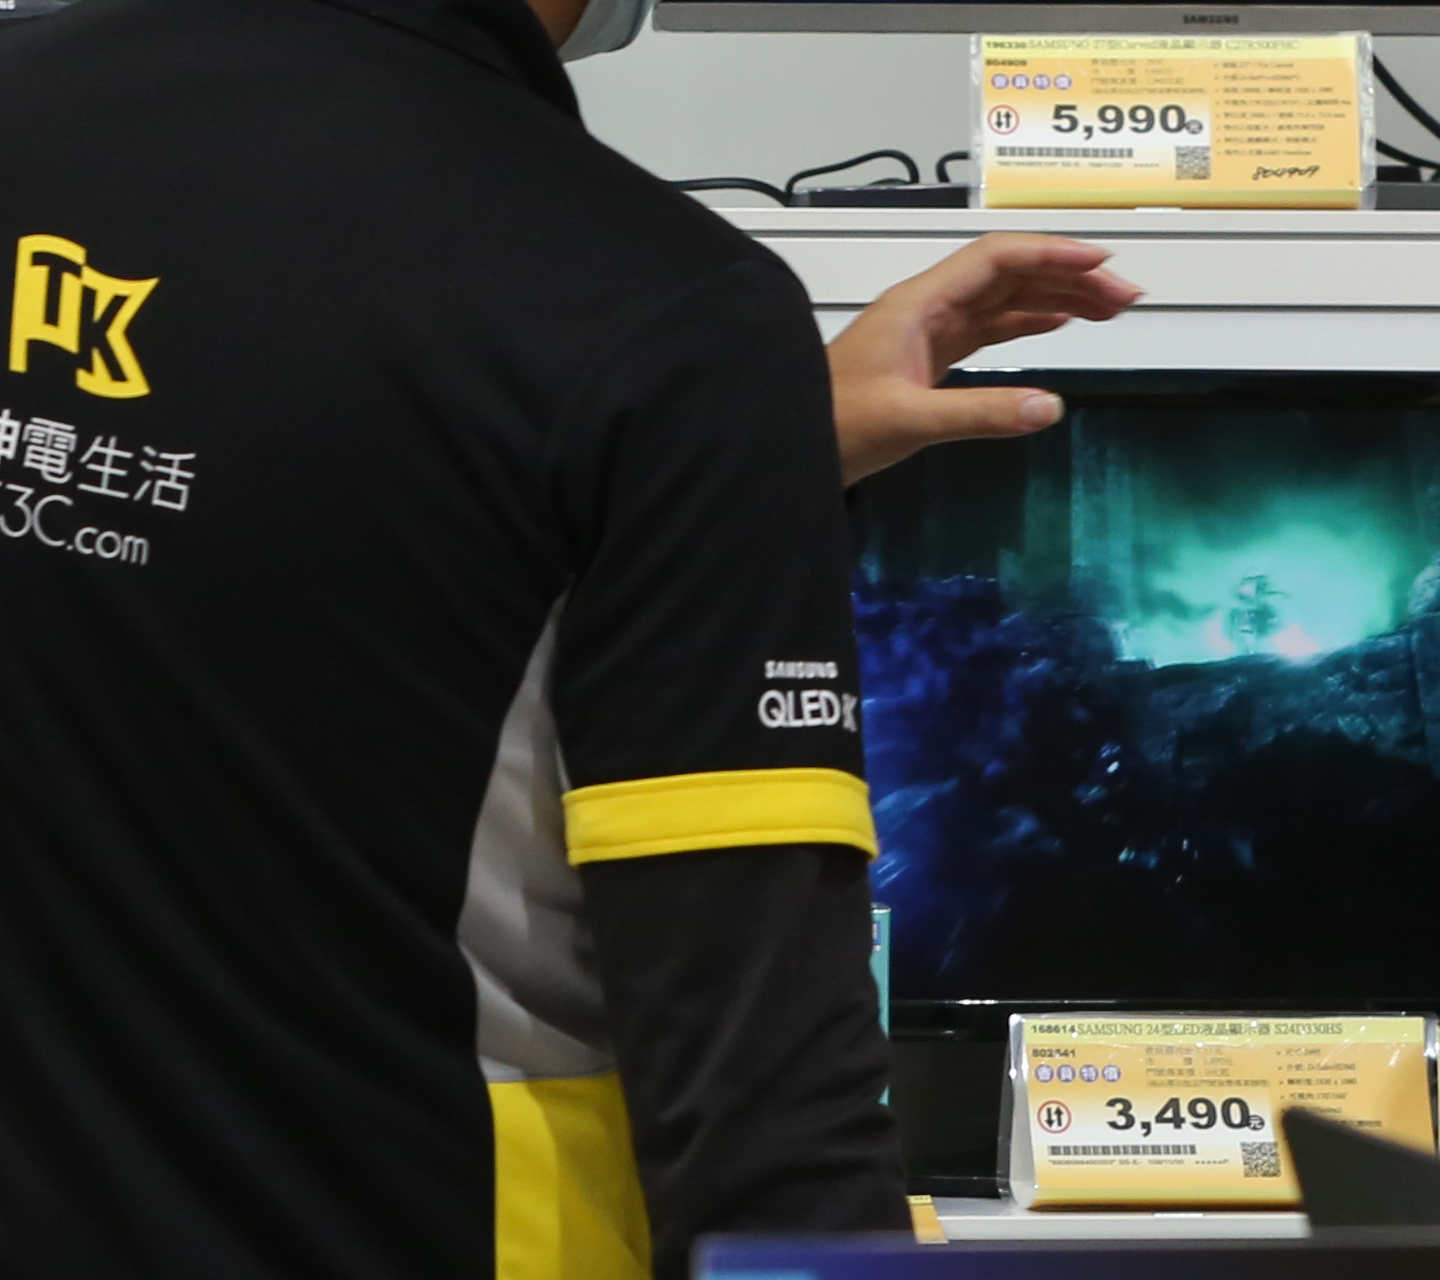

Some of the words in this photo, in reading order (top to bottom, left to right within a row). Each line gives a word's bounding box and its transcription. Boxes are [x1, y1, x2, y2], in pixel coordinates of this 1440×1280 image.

[1051, 103, 1187, 141] 5,990
[764, 659, 839, 679] SAMSUNG
[757, 688, 842, 729] QLED
[1077, 1023, 1143, 1036] SAMSUNG
[1105, 1096, 1251, 1138] 3,490
[1248, 1114, 1265, 1131] 元
